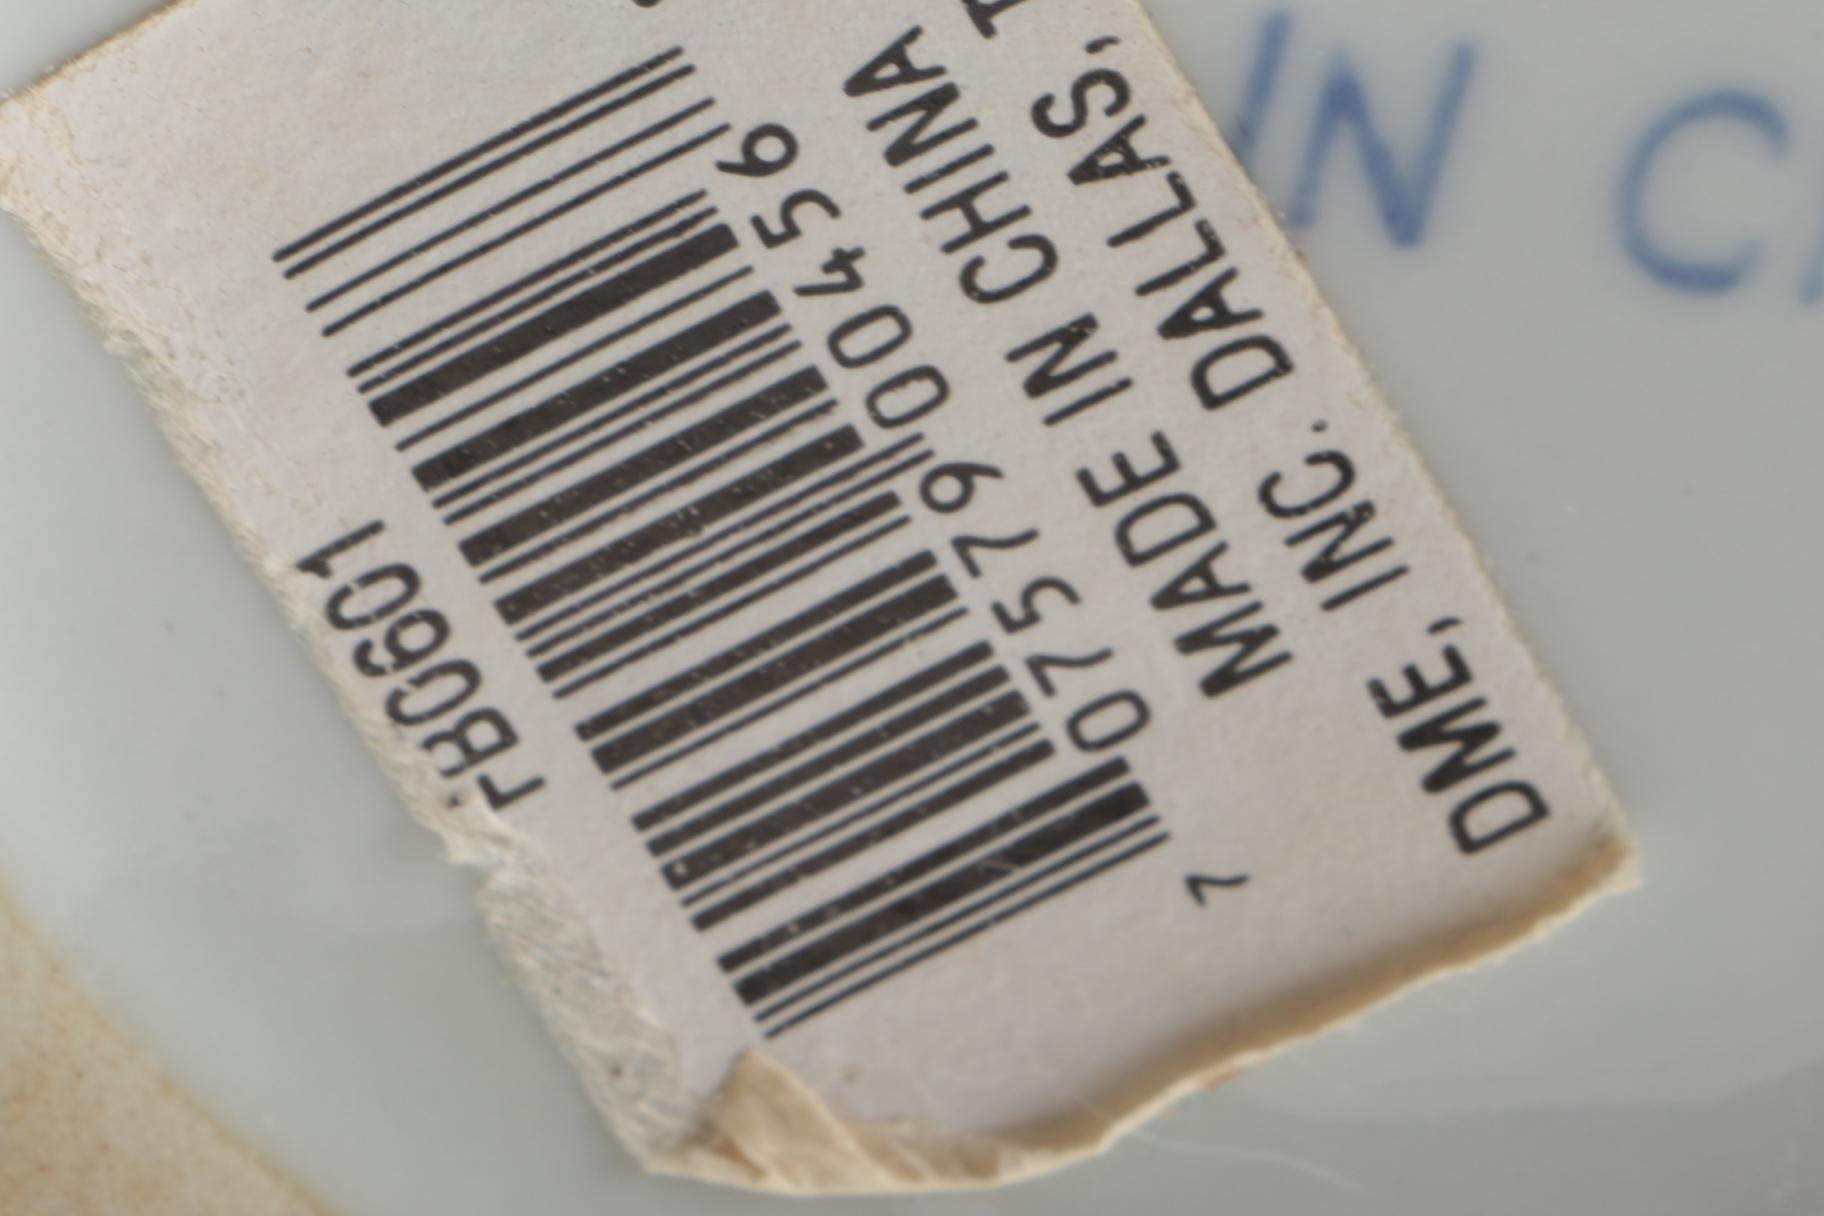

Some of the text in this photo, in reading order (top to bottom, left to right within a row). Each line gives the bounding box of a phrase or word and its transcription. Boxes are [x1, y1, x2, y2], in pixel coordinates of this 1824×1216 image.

[1030, 34, 1295, 412] DALLAS,
[1238, 8, 1476, 248] IN
[715, 122, 950, 430] 00456
[843, 25, 1293, 699] MADE IN CHINA
[918, 461, 1151, 753] 07579
[1257, 418, 1410, 612] INC.
[1366, 616, 1551, 856] DME,
[1184, 873, 1249, 907] 7
